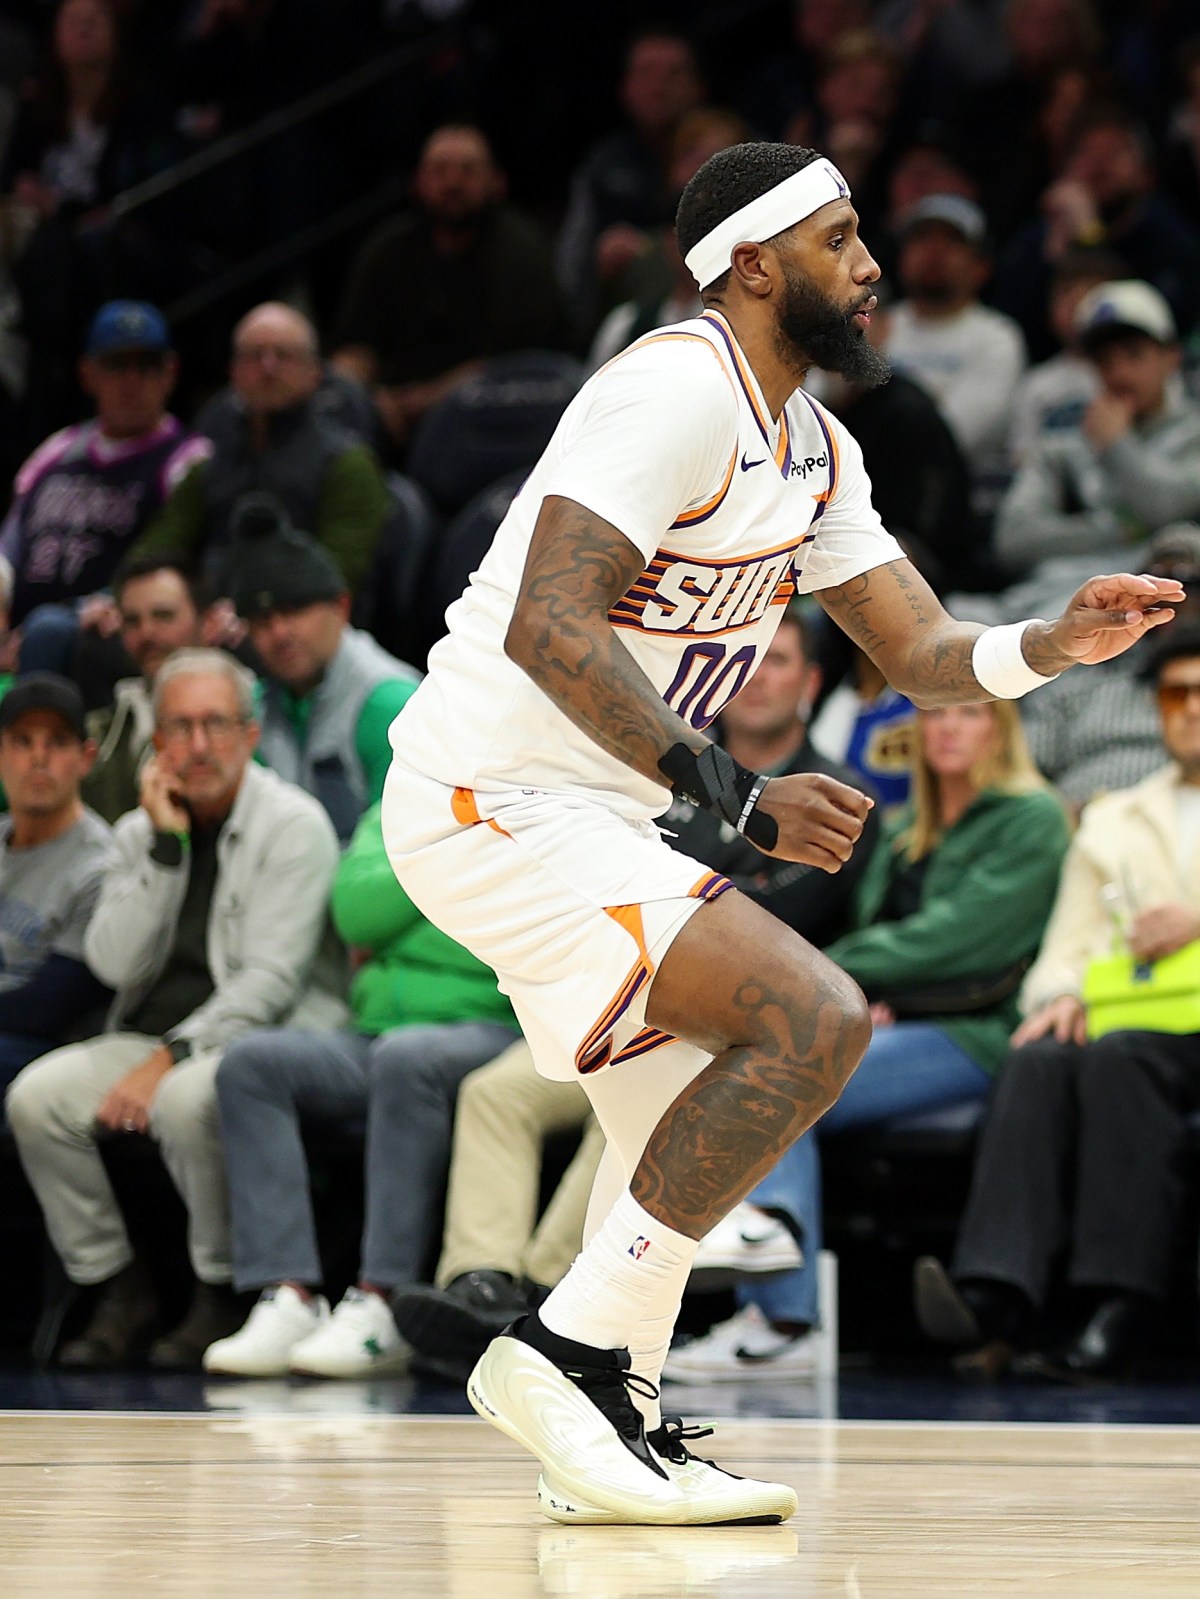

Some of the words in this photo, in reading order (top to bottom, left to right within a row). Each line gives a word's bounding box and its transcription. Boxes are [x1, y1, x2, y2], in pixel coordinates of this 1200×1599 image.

[791, 451, 828, 479] PayPal
[641, 552, 796, 632] SUN
[662, 642, 757, 731] 00
